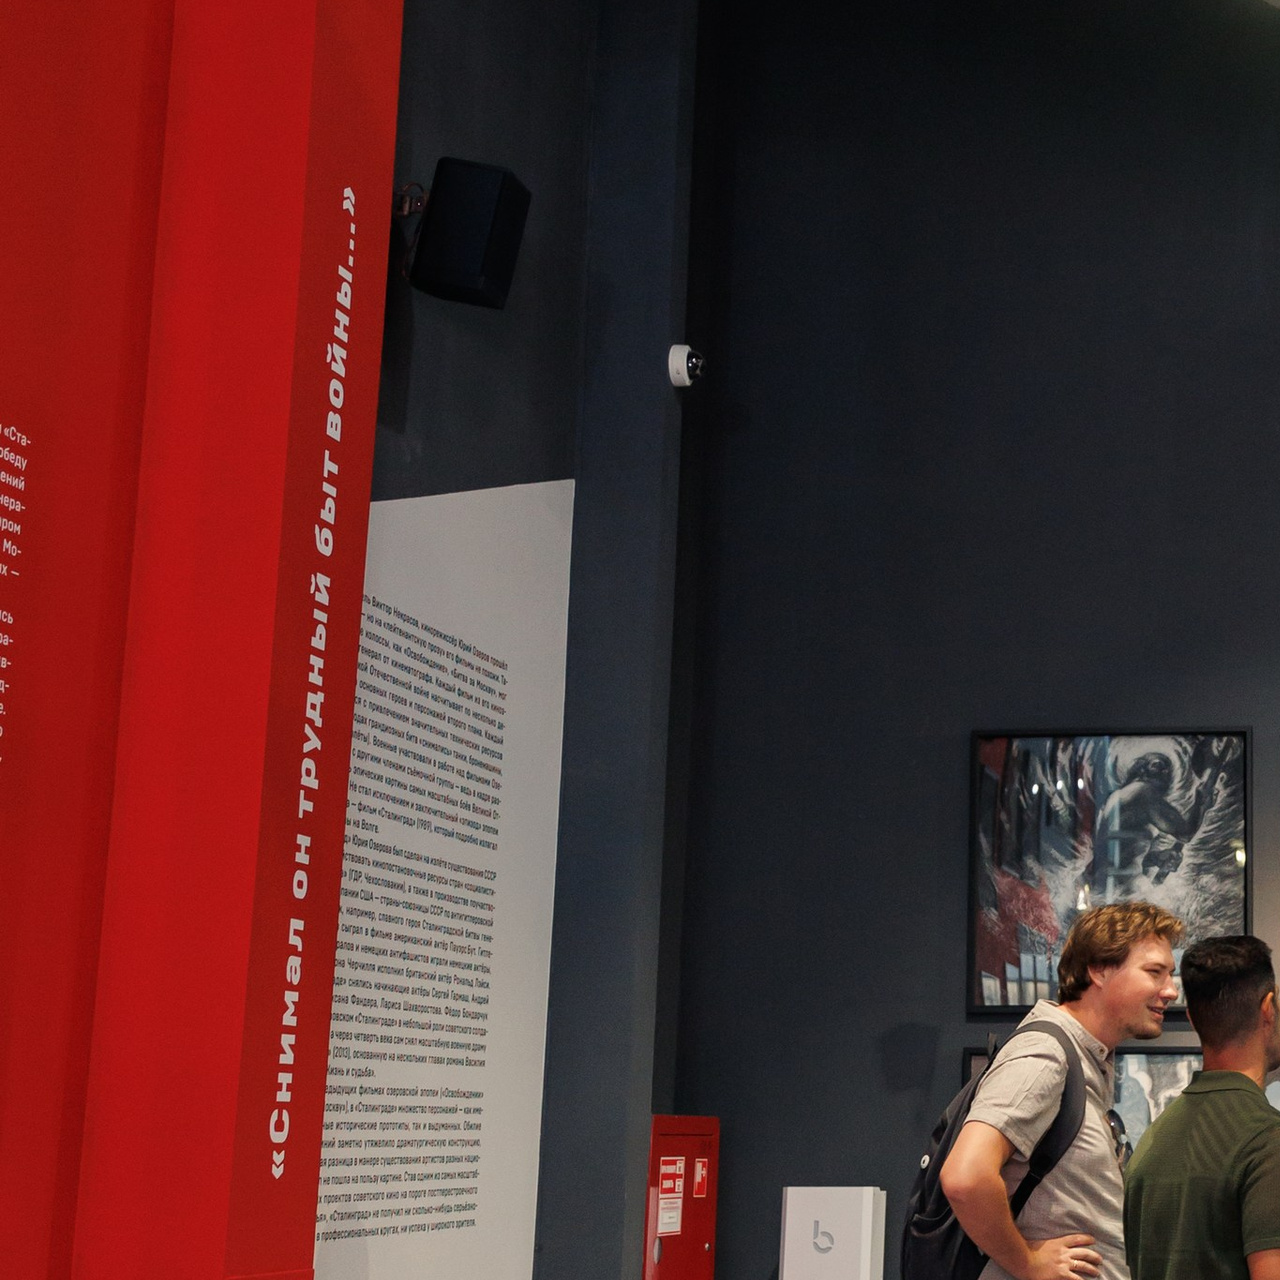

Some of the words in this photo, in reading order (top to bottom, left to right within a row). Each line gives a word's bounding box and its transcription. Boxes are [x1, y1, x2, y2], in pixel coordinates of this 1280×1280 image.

[4, 426, 31, 447] «Ста-
[315, 450, 338, 556] быт
[3, 538, 21, 557] Мо-
[299, 573, 330, 818] трудный
[293, 834, 311, 899] он
[270, 918, 304, 1179] «Снимал
